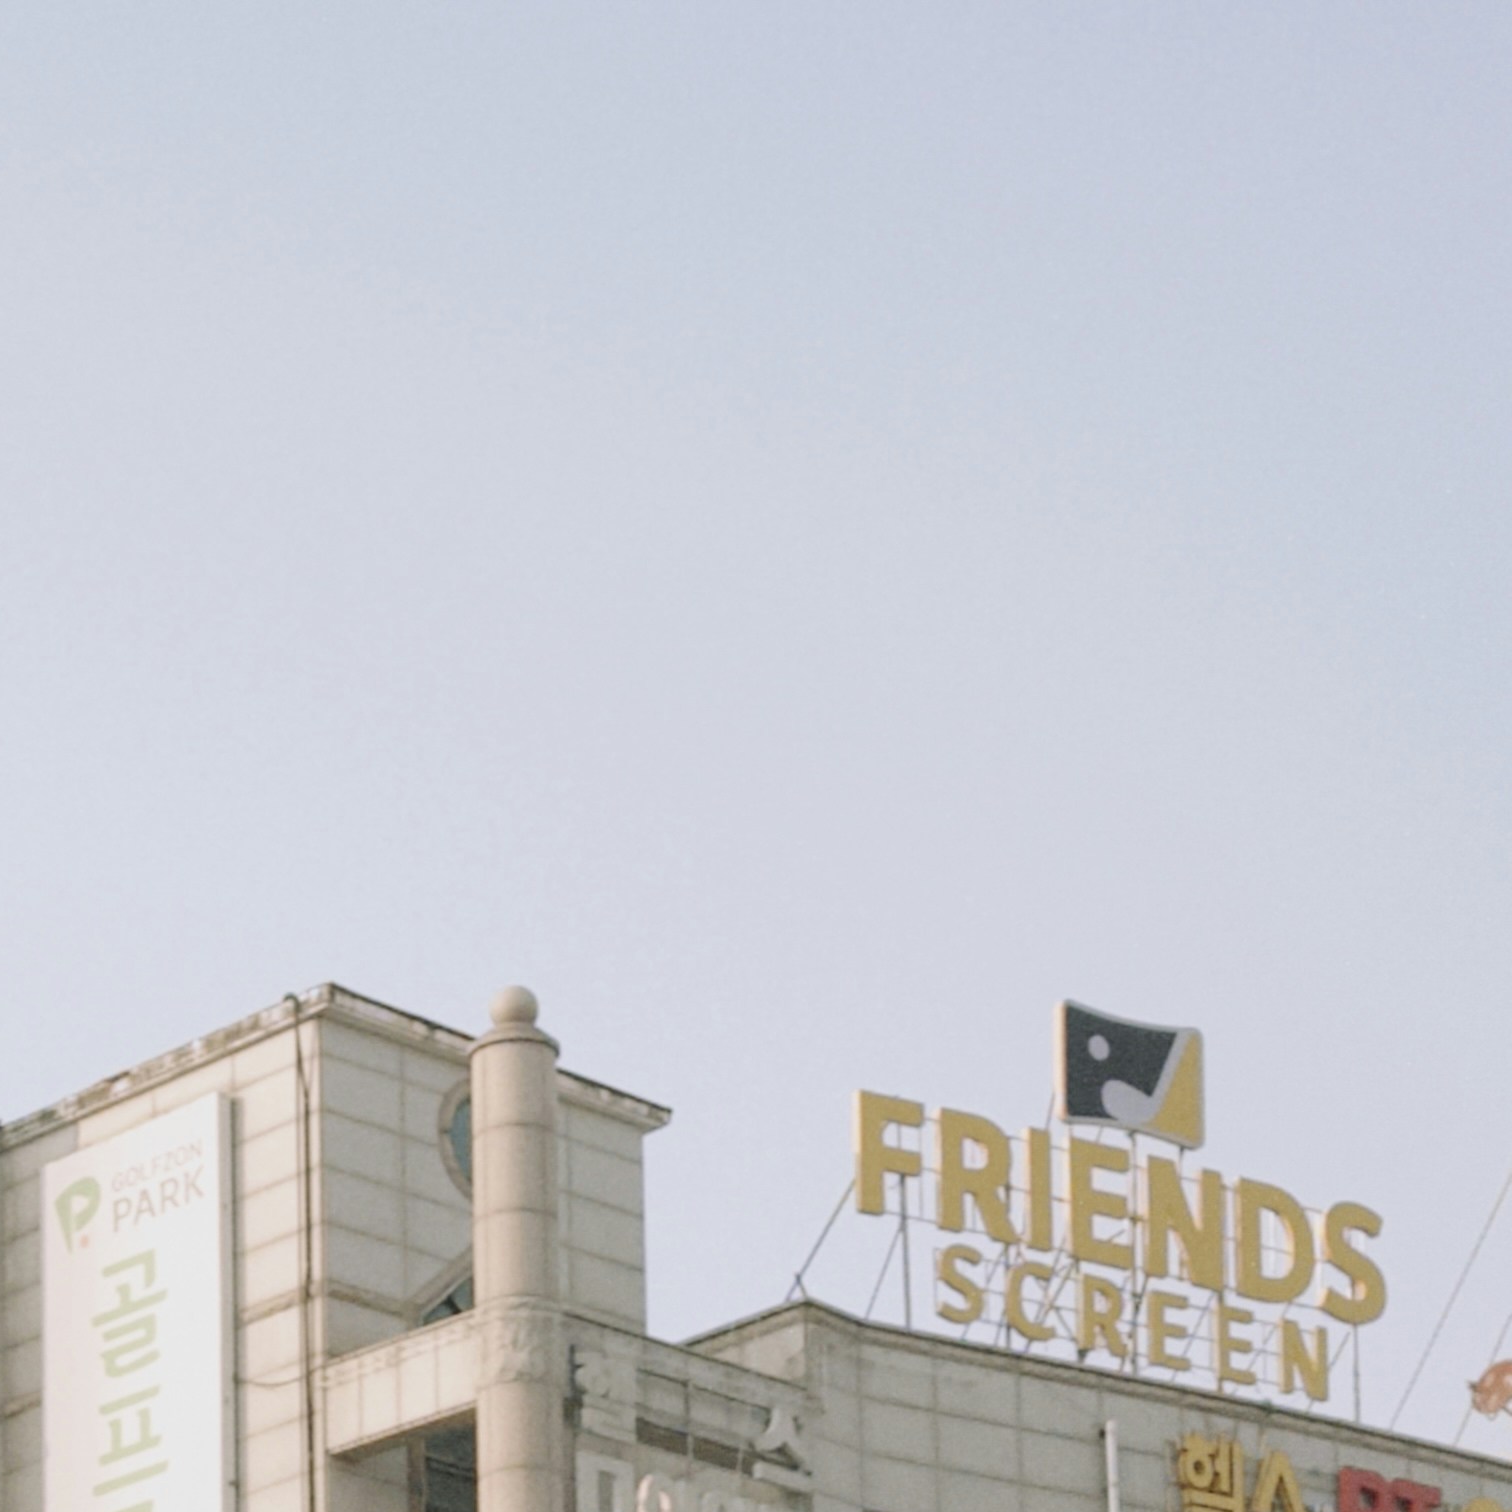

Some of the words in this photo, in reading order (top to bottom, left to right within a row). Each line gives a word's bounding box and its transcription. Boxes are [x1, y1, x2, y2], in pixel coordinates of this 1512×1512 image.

[110, 1138, 204, 1193] GOLFZON
[111, 1164, 206, 1233] PARK
[853, 1088, 1387, 1326] FRIENDS
[934, 1244, 1329, 1402] SCREEN
